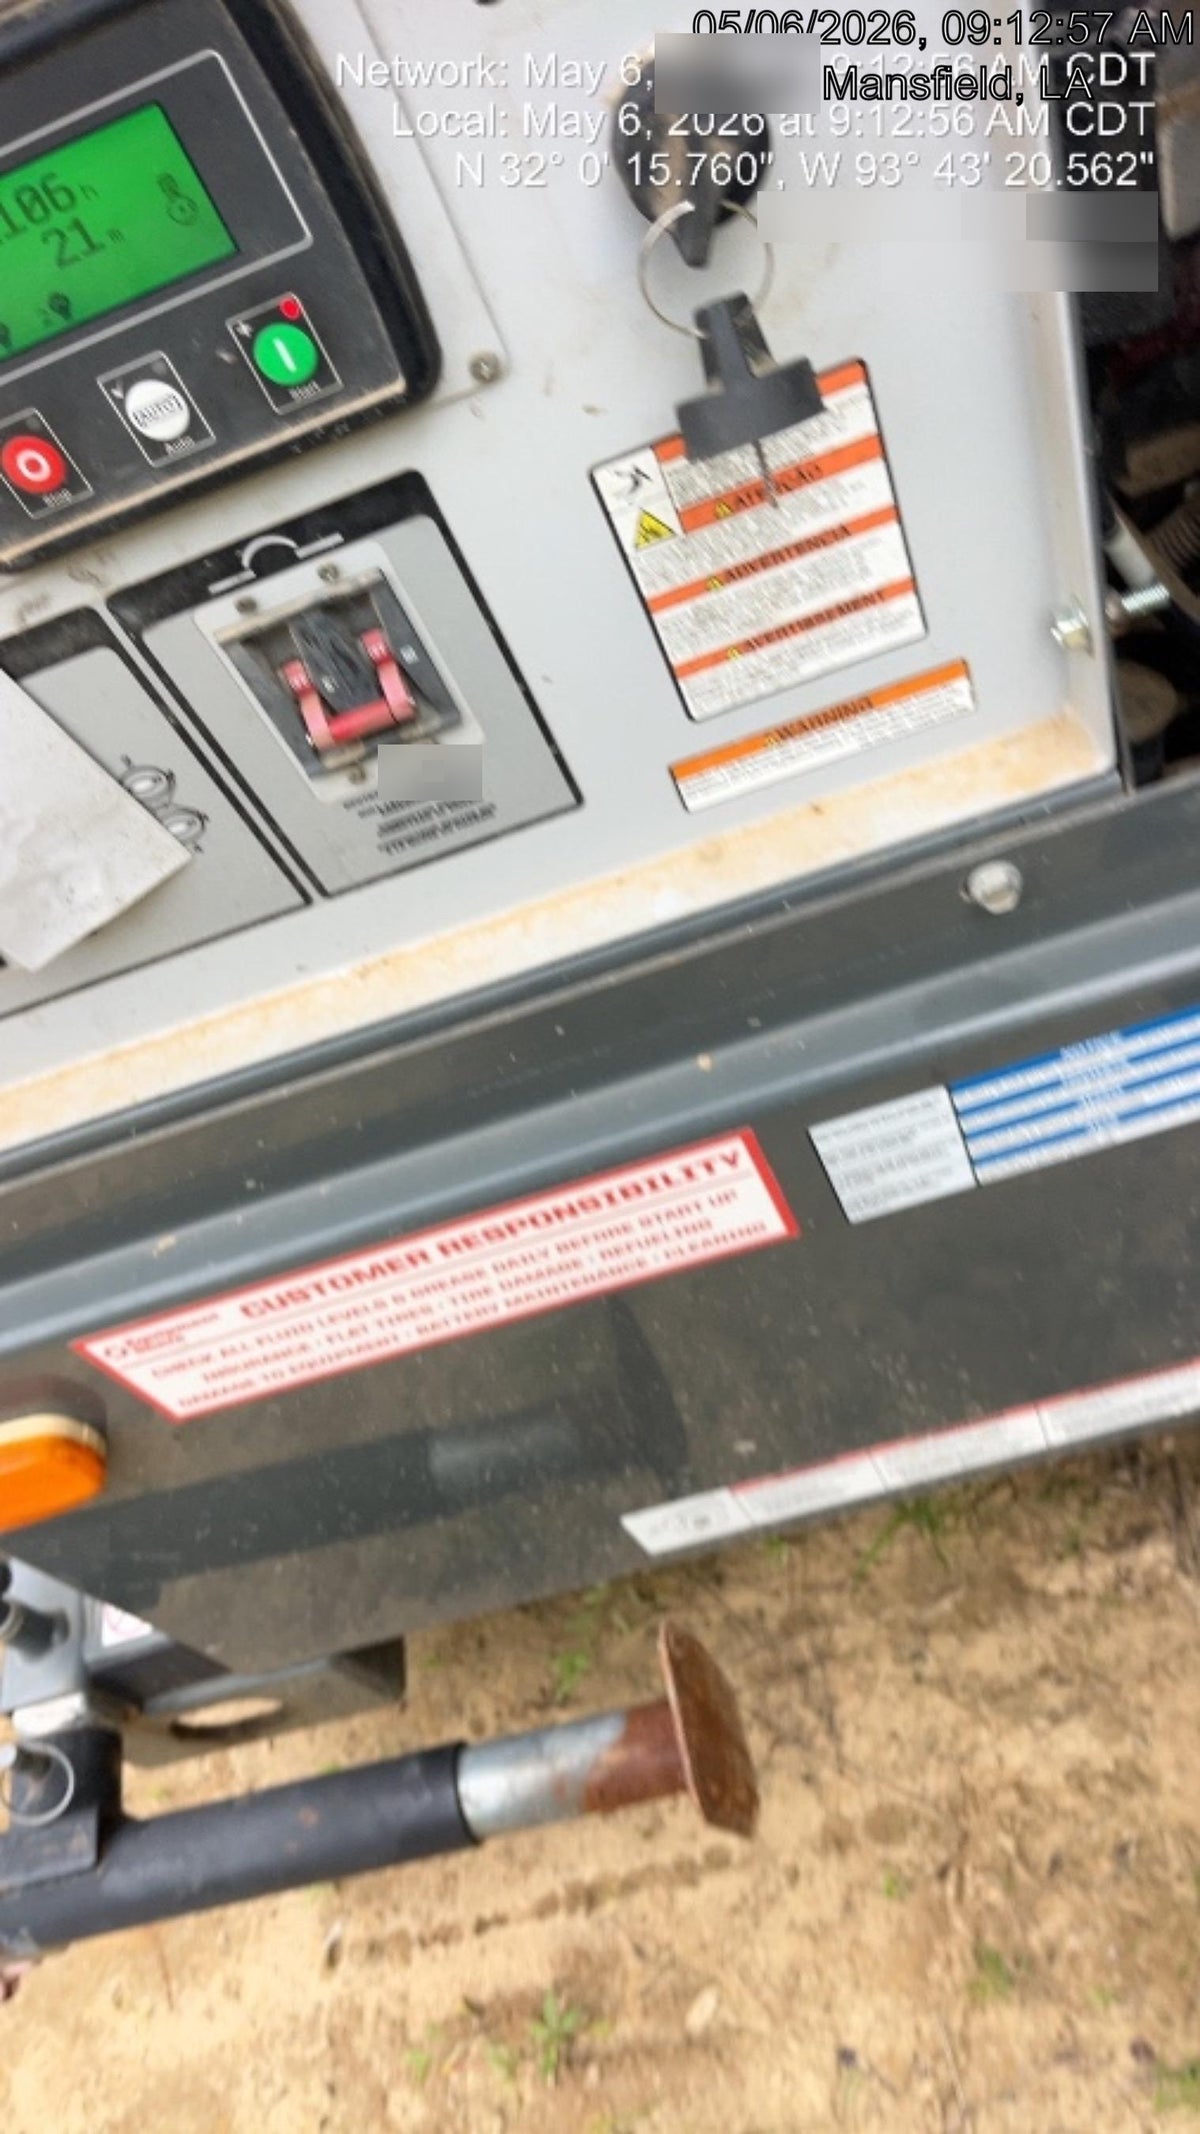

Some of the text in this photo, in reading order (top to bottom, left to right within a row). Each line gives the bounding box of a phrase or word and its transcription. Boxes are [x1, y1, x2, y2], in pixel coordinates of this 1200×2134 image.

[776, 695, 874, 741] WARNING
[241, 1250, 430, 1317] CUSTOMER
[437, 1150, 738, 1257] RESPONSIBILITY
